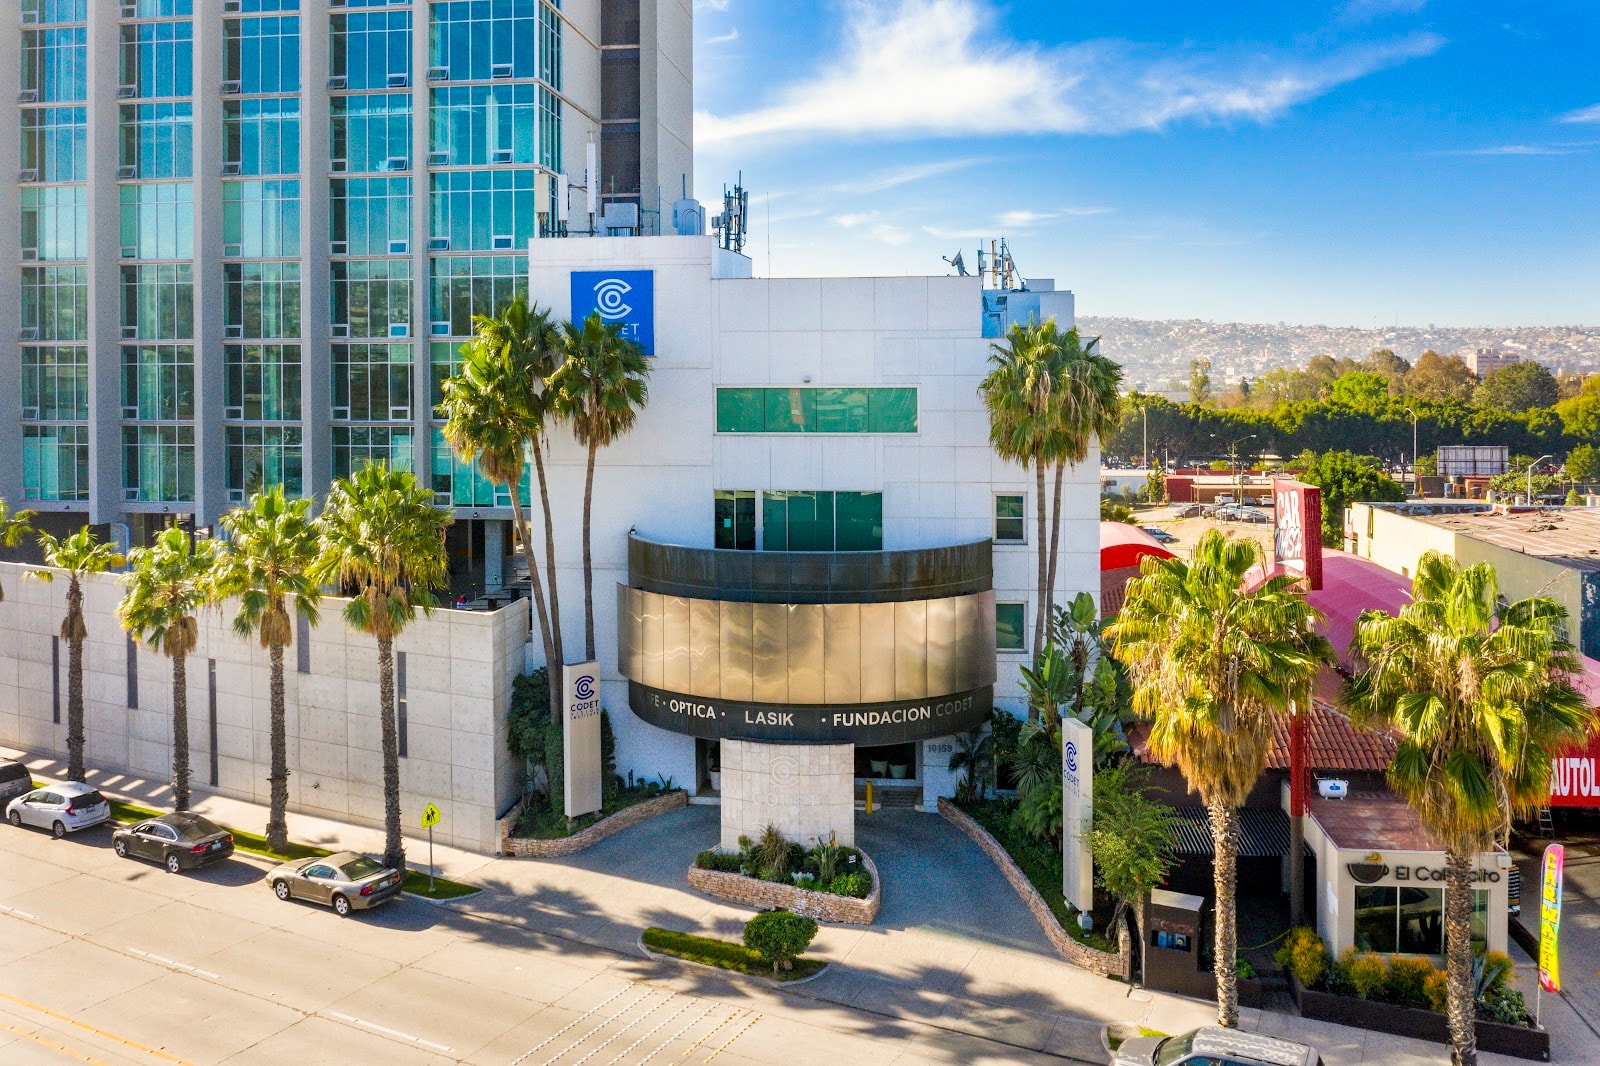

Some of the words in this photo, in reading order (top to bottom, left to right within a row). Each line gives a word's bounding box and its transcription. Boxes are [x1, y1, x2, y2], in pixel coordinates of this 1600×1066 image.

[1276, 490, 1301, 530] CAR
[1275, 526, 1303, 560] WASH
[570, 699, 600, 712] CODET
[669, 699, 717, 720] OPTICA
[745, 710, 794, 727] LASIK
[833, 705, 931, 727] FUNDACION
[935, 696, 974, 717] CODET
[1550, 757, 1600, 796] AUTOL
[1395, 866, 1409, 881] El
[1415, 865, 1501, 883] Cafcito
